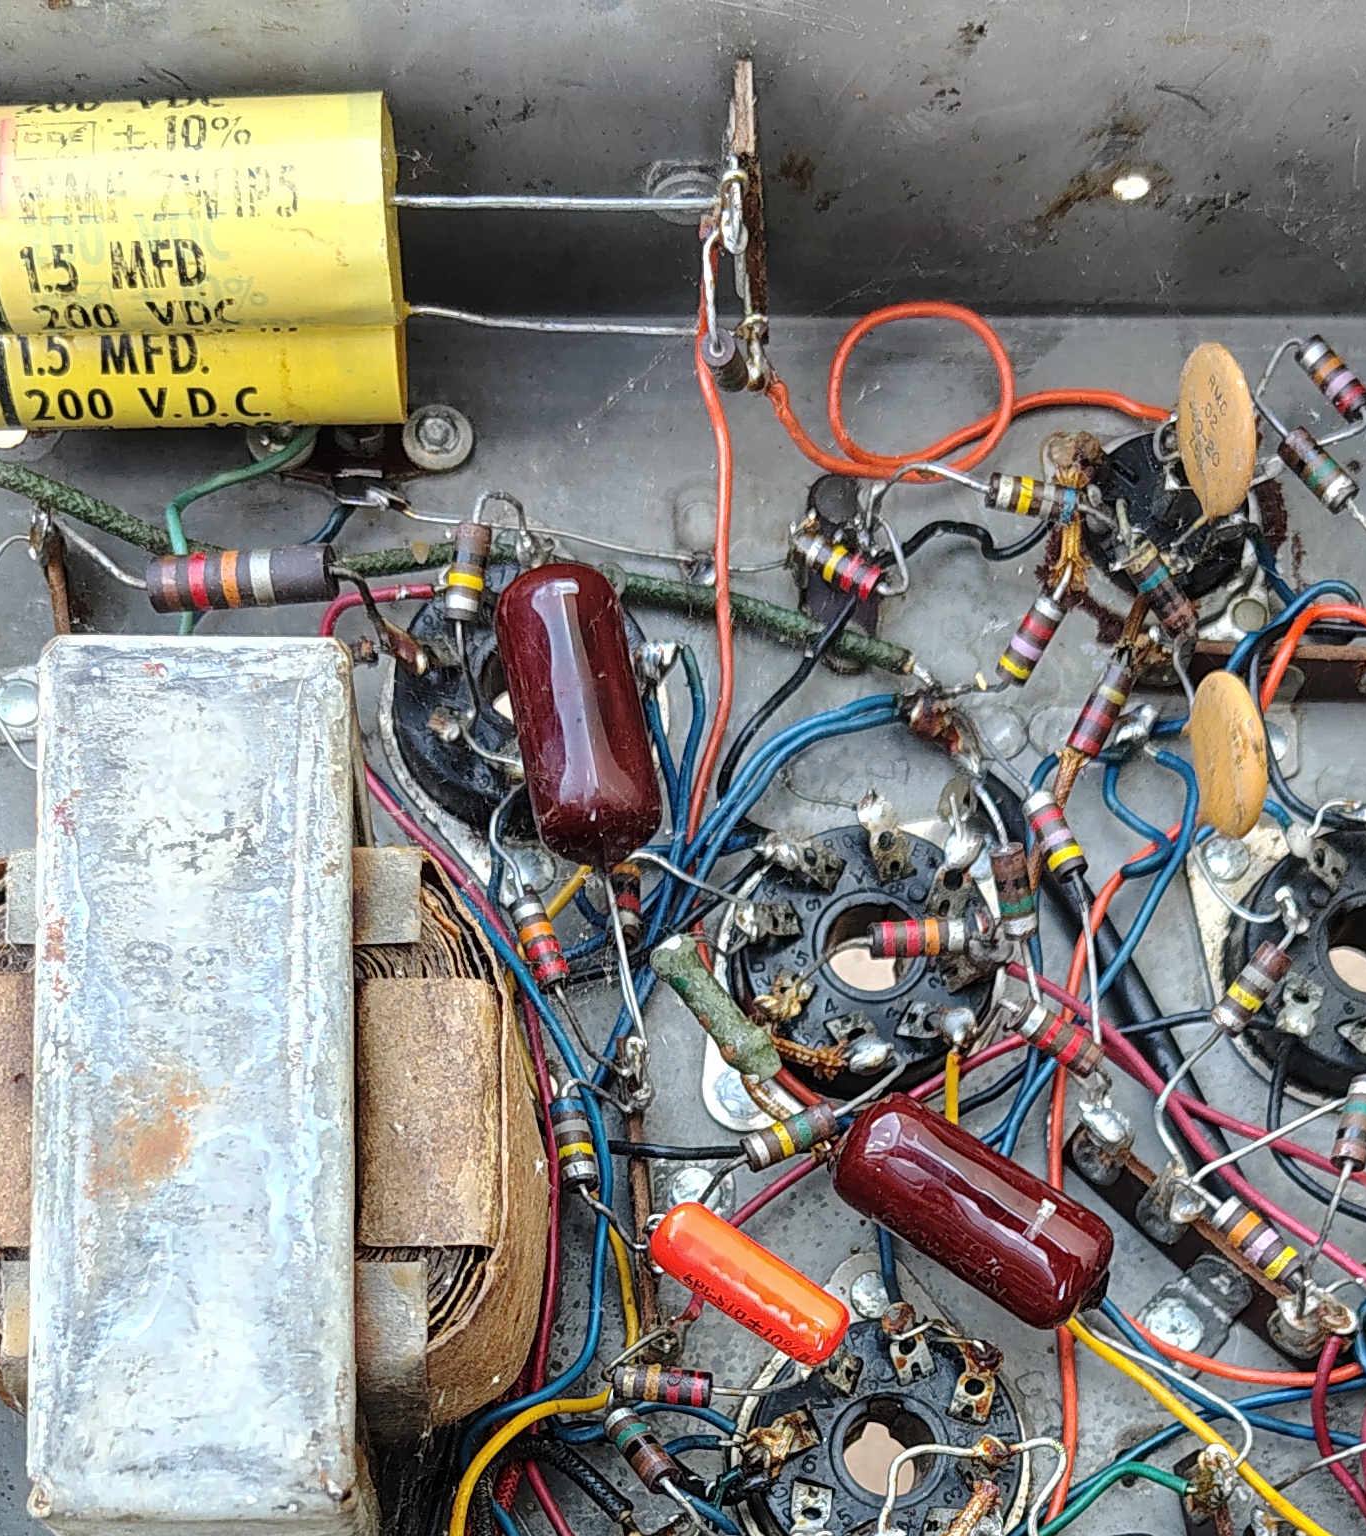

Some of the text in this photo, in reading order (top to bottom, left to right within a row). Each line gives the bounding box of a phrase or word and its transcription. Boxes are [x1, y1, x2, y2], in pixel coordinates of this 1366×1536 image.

[165, 114, 252, 151] 10%
[20, 243, 79, 294] 1.5
[32, 298, 241, 330] 200 VDC
[16, 333, 211, 376] 1.5 MFD.
[24, 386, 272, 421] 200 V.D.C.
